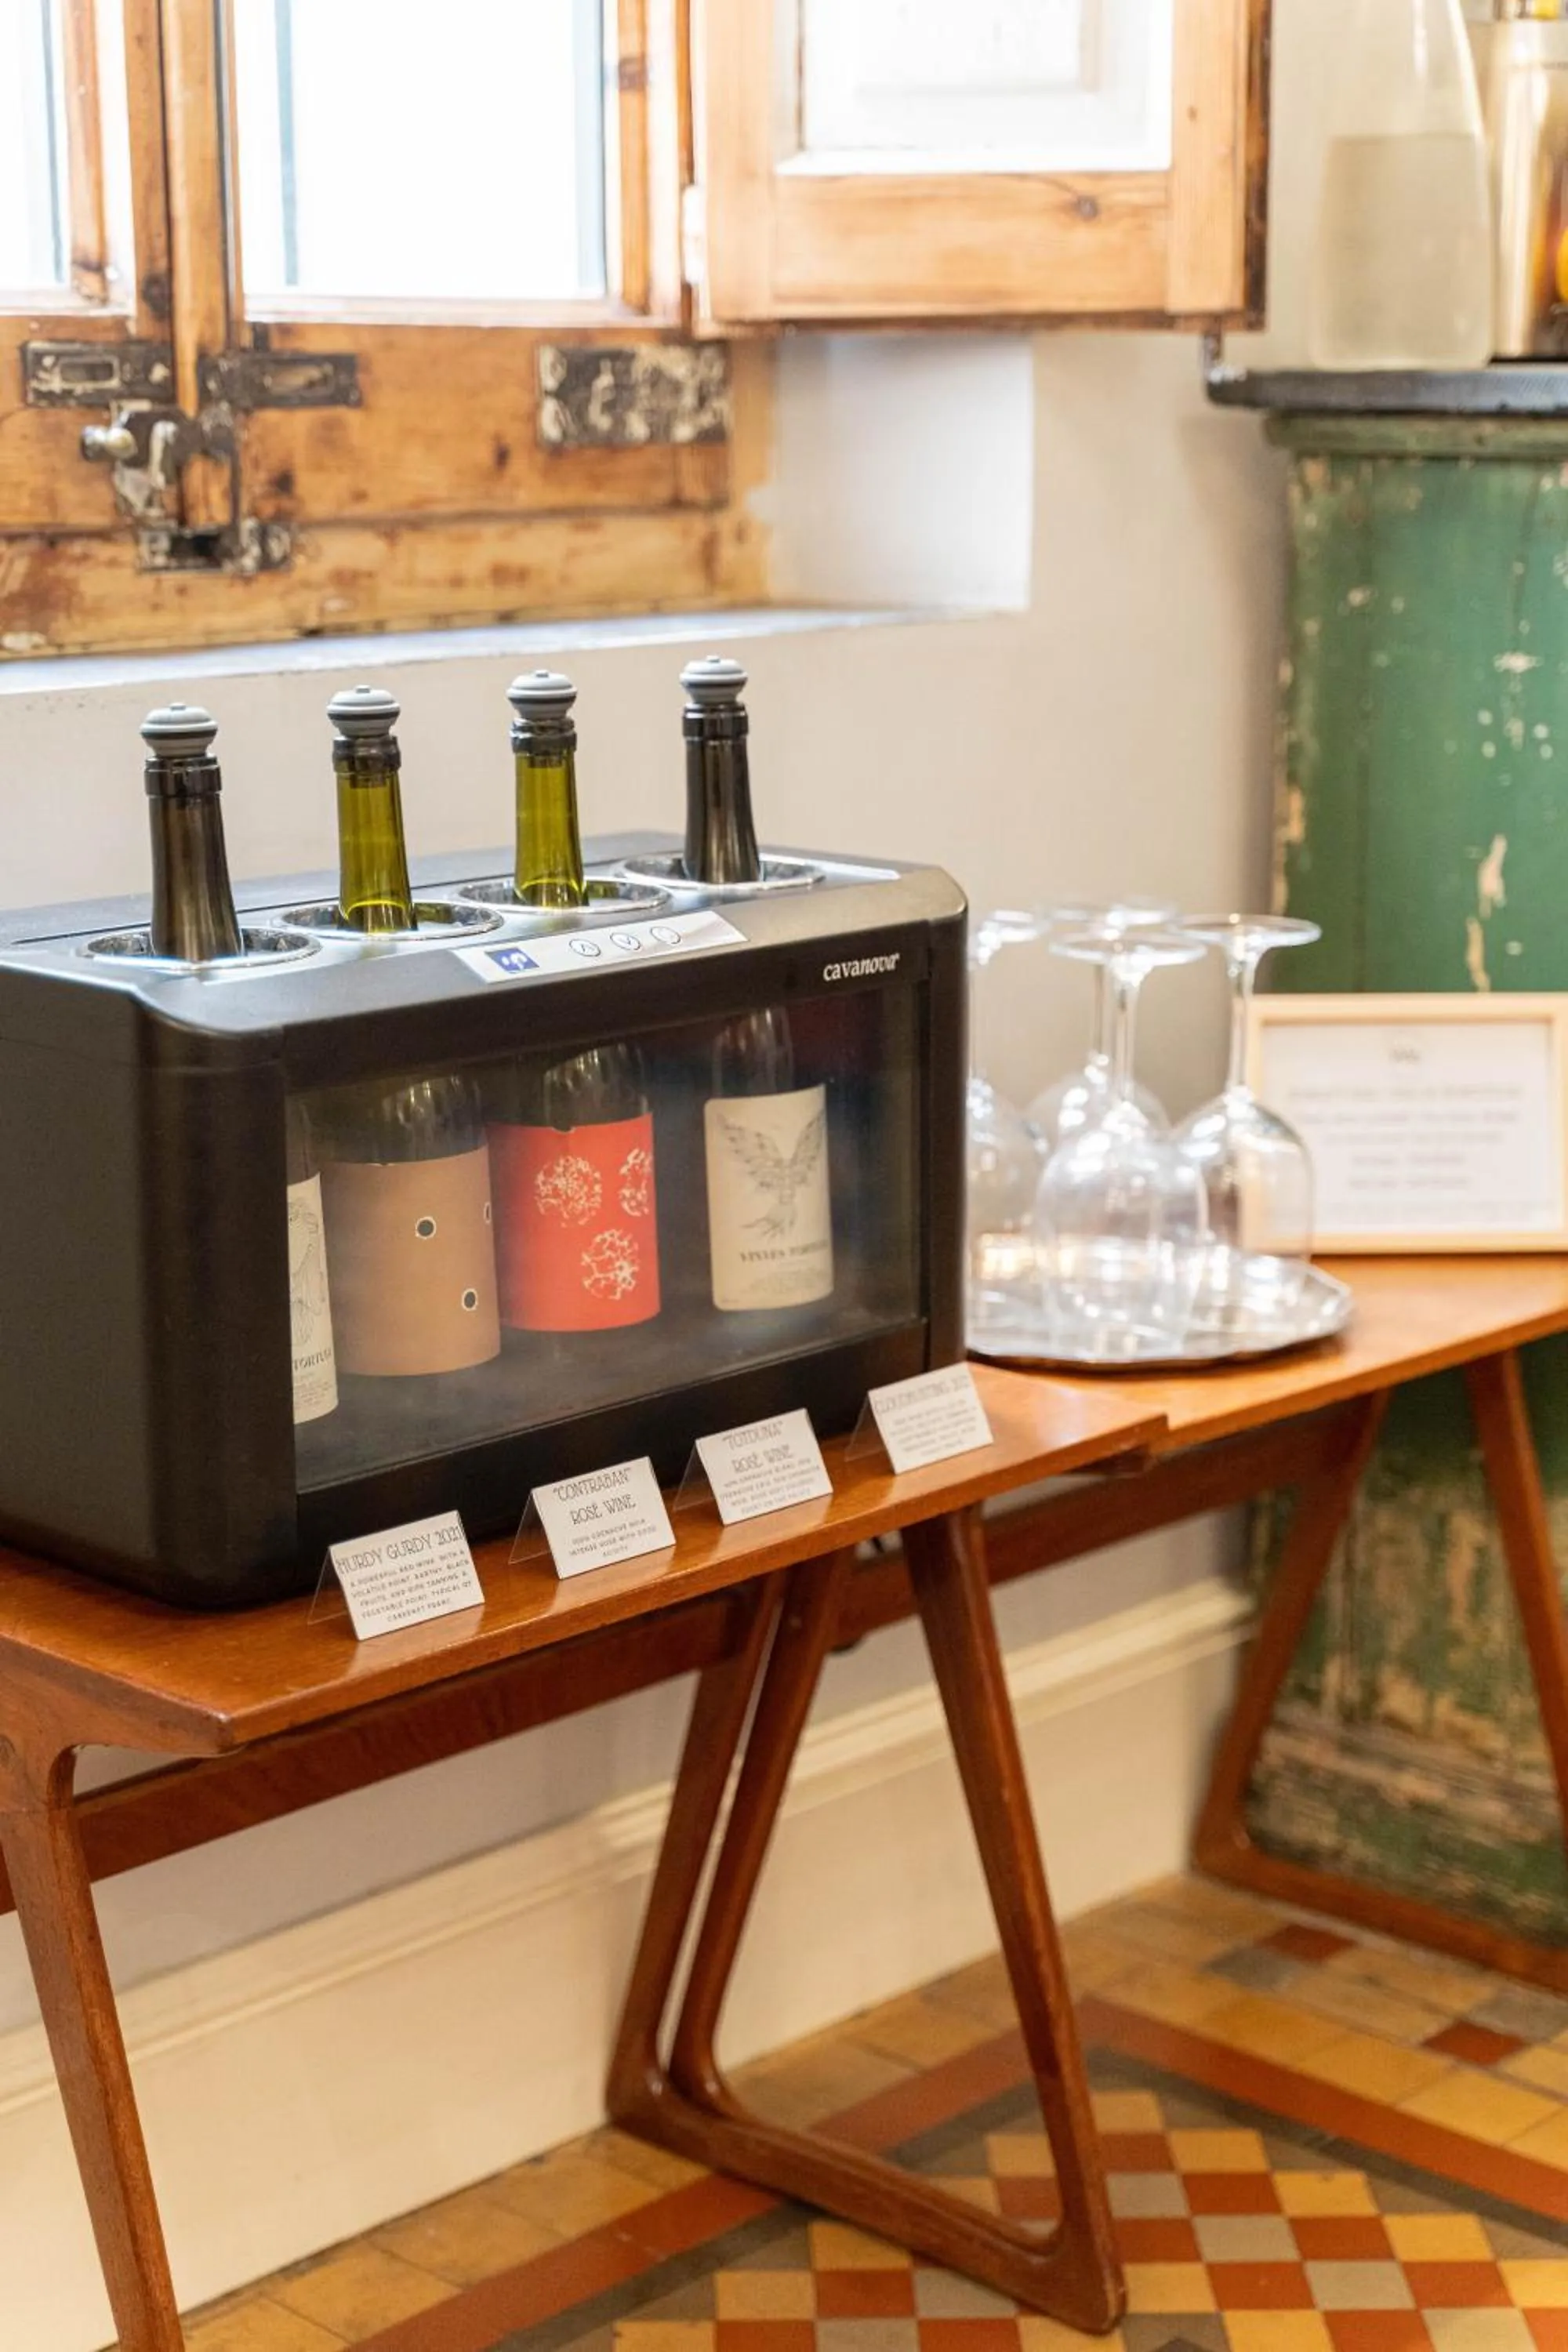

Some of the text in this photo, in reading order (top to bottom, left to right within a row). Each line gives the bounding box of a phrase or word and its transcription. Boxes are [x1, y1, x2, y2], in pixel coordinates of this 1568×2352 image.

[823, 953, 900, 982] cavanova
[602, 1494, 637, 1515] WINE
[335, 1548, 383, 1574] HURDY
[386, 1534, 432, 1560] GURDY
